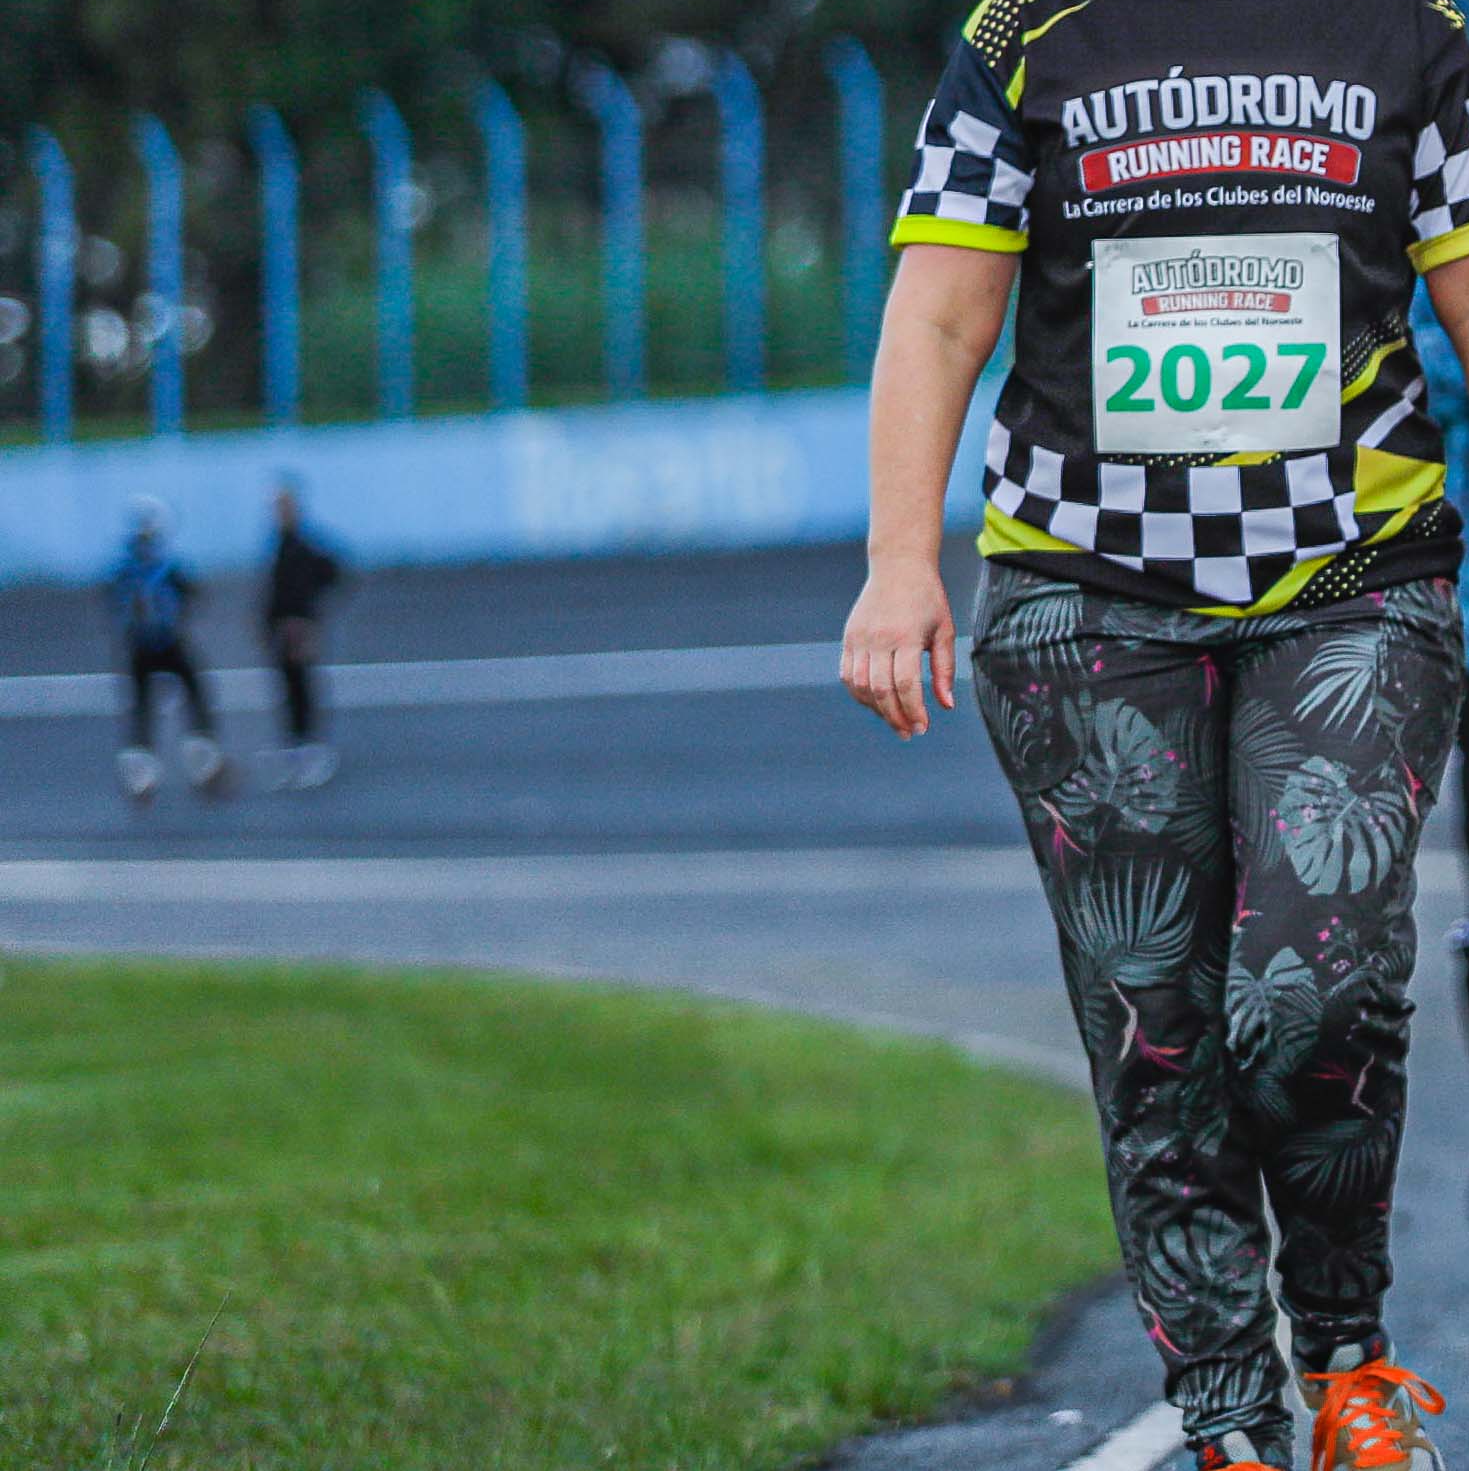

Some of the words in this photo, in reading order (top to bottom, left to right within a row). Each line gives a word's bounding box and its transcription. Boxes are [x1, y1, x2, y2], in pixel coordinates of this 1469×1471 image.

[1061, 65, 1377, 147] AUTÓDROMO
[1107, 135, 1242, 184] RUNNING
[1250, 135, 1331, 176] RACE
[1063, 201, 1081, 219] La
[1082, 193, 1144, 217] Carrera
[1150, 189, 1173, 209] de
[1175, 188, 1203, 208] los
[1206, 186, 1269, 207] Clubes
[1275, 185, 1301, 206] del
[1304, 185, 1376, 214] Noroeste
[1131, 248, 1304, 295] AUTÓDROMO
[1158, 293, 1228, 312] RUNNING
[1232, 292, 1275, 310] RACE
[1105, 342, 1328, 413] 2027
